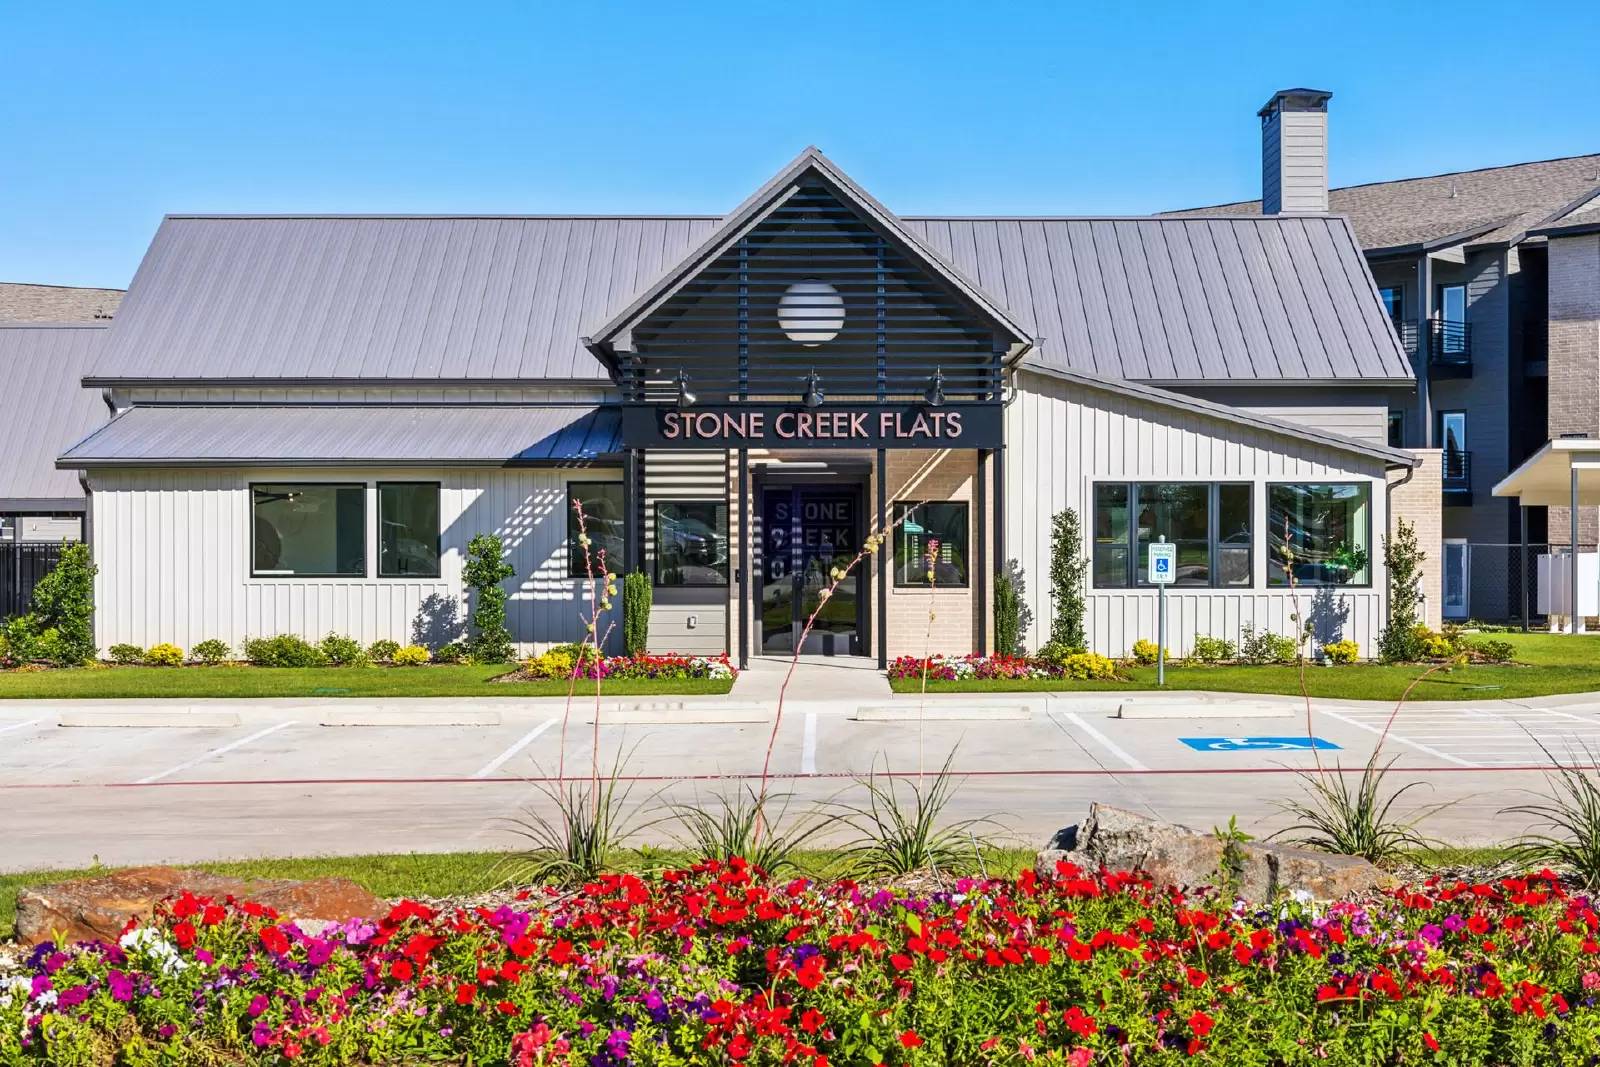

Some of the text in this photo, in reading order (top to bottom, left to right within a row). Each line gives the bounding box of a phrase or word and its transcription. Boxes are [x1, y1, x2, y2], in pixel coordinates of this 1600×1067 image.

[663, 412, 963, 438] STONE CREEK FLATS
[775, 502, 849, 520] SONE
